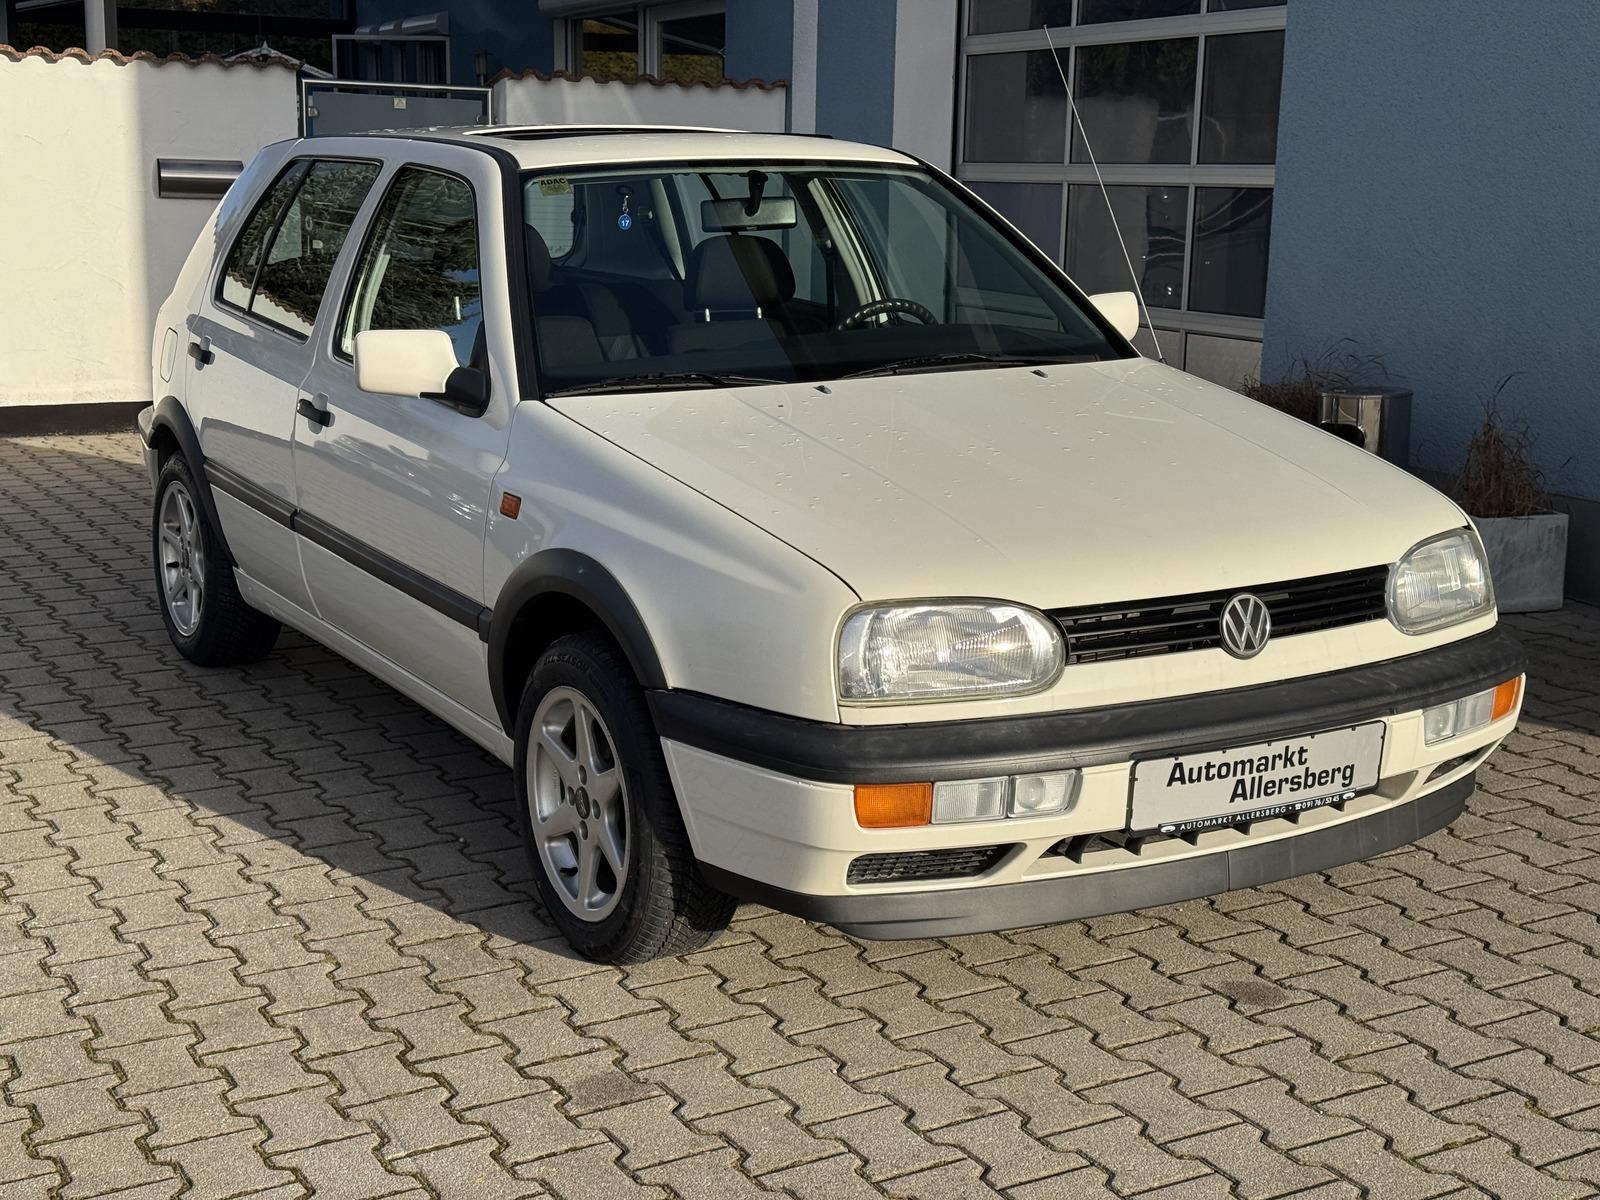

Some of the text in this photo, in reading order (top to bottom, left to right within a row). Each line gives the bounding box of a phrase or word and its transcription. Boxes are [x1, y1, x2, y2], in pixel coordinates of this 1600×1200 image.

[541, 178, 566, 186] ADAC
[1167, 746, 1308, 787] Automarkt
[1229, 764, 1355, 803] Allersberg
[1180, 816, 1233, 831] AUTOMARKT
[1236, 806, 1286, 822] ALLERSBERG
